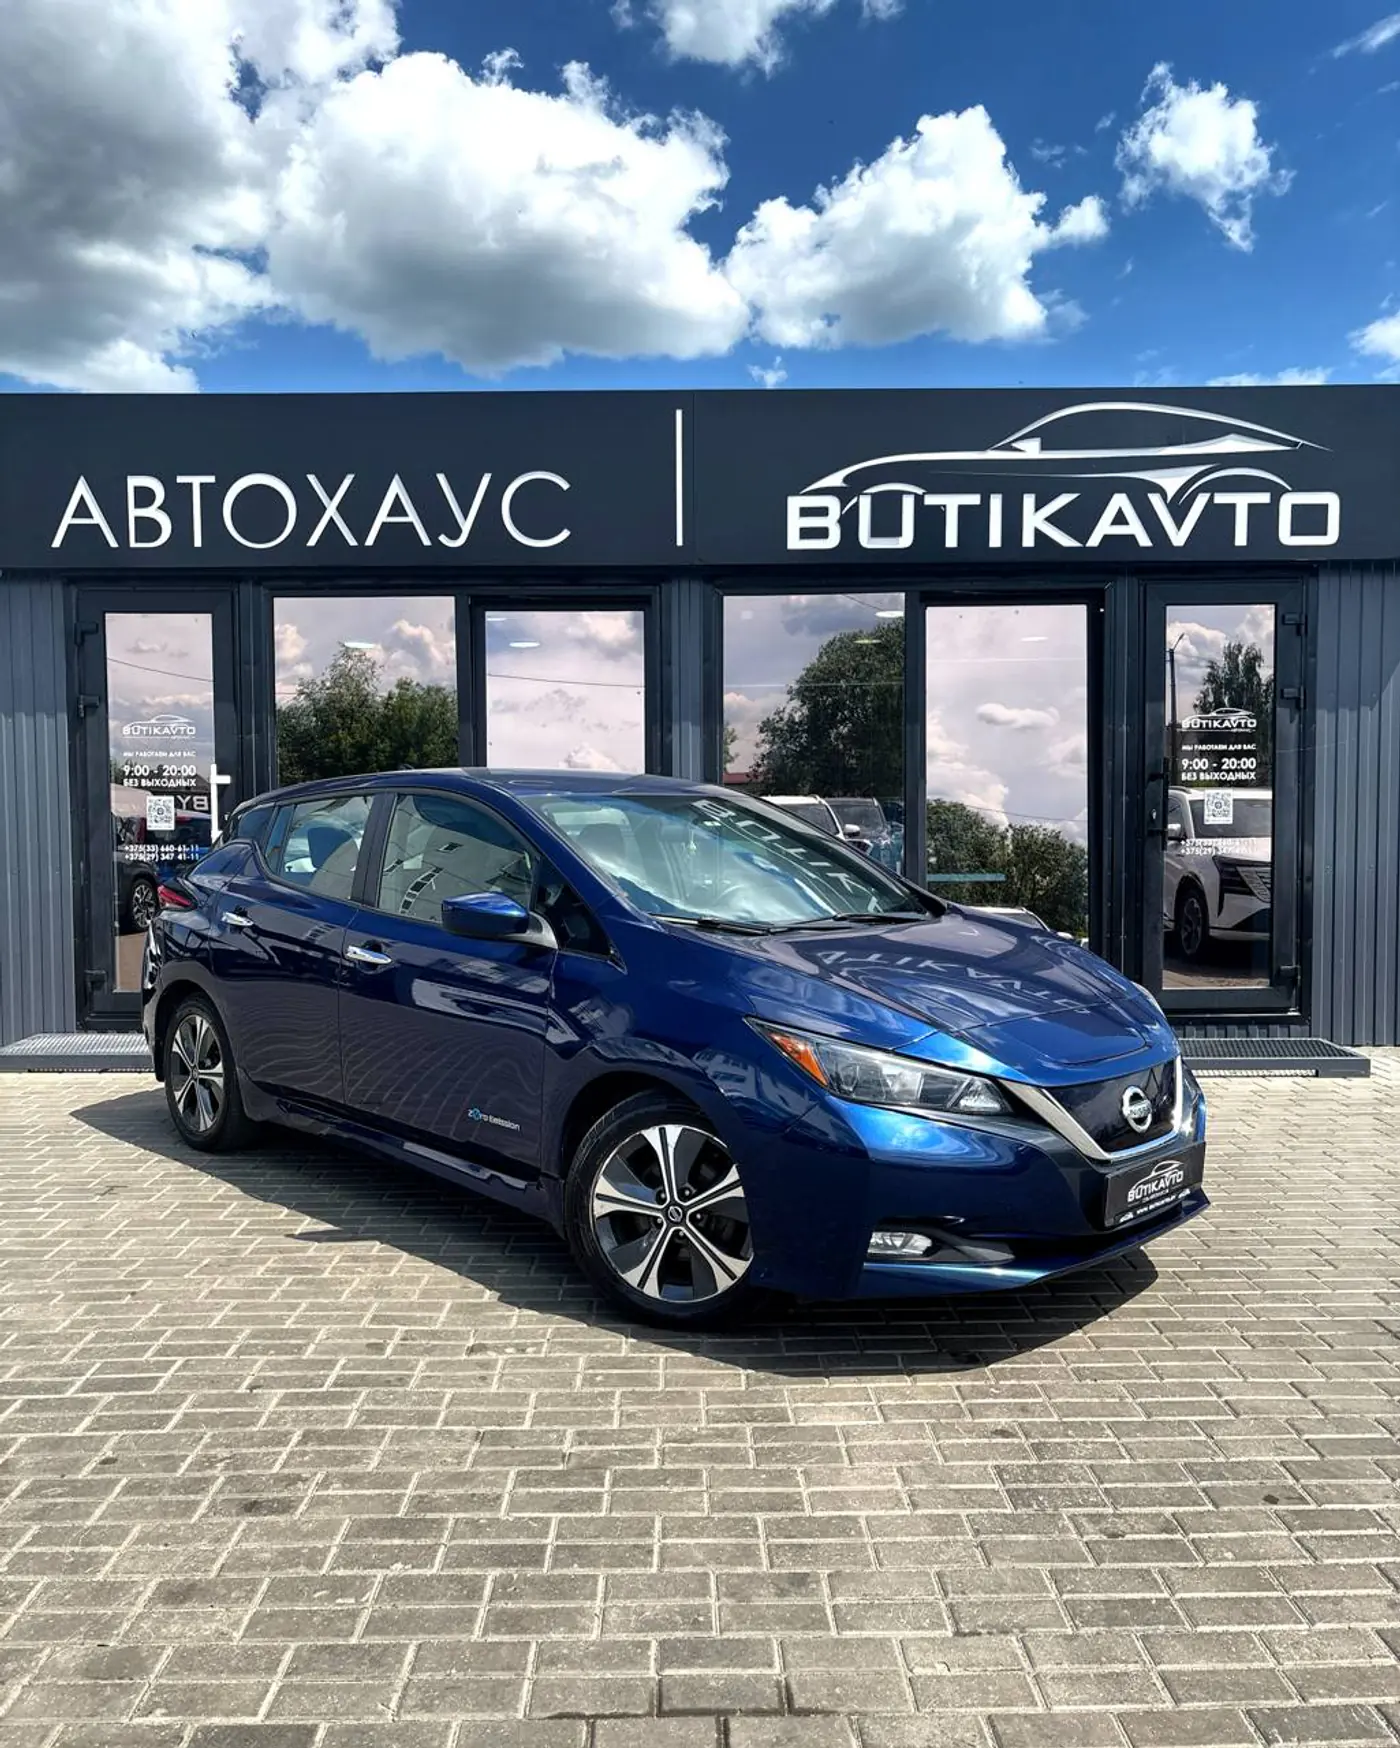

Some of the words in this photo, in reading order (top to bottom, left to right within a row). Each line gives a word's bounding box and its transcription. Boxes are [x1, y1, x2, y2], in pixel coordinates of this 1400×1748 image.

[52, 471, 572, 549] АВТОХАУС
[787, 491, 1342, 550] BUTIKAVTO
[1181, 718, 1257, 729] BUTIKAVTO
[122, 725, 196, 736] BUTIKAVTO
[1181, 758, 1208, 770] 9:00
[1221, 758, 1257, 770] 20:00
[123, 765, 149, 776] 9:00
[162, 765, 196, 776] 20:00
[1181, 772, 1197, 781] БЕЗ
[1199, 771, 1256, 781] ВЫХОДНЫХ
[123, 778, 139, 787] БЕЗ
[141, 778, 196, 787] ВЫХОДНЫХ
[1127, 1171, 1184, 1202] BUTIKAVTO
